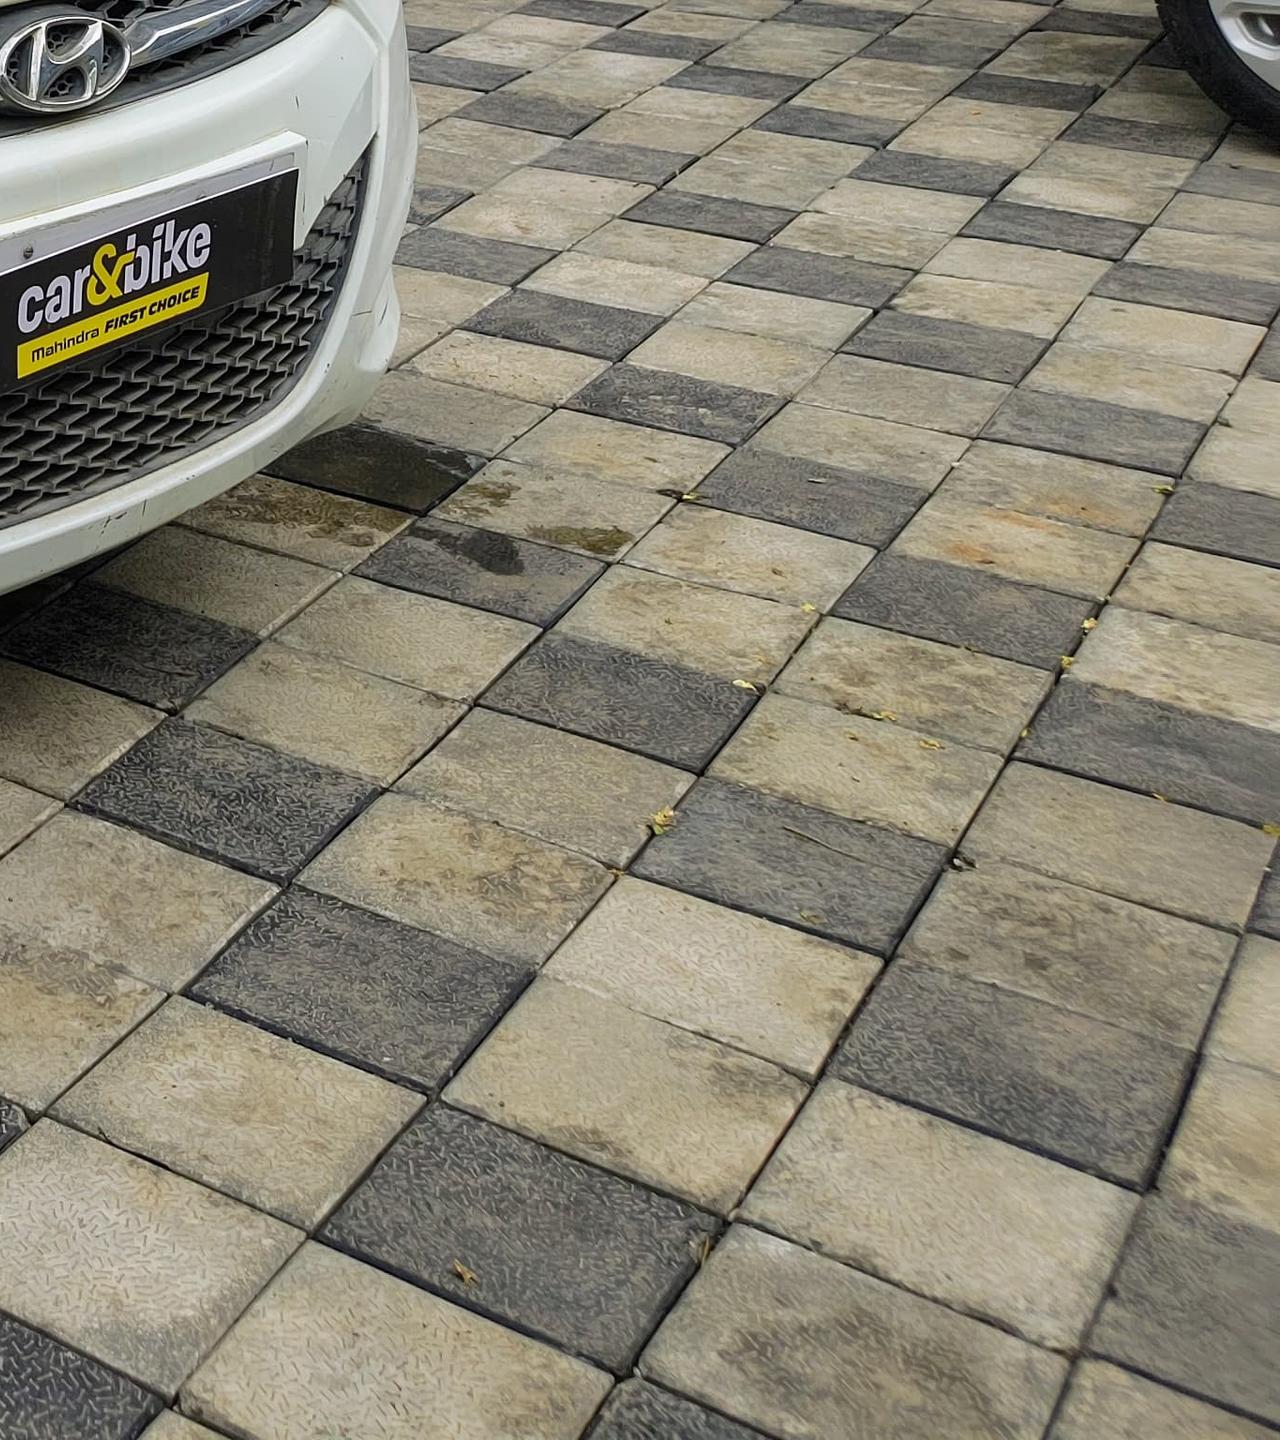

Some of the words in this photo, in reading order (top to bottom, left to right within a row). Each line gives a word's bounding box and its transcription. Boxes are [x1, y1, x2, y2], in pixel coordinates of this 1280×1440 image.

[17, 219, 211, 334] car&bike
[31, 327, 100, 363] Mahindra
[104, 308, 148, 334] FIRST
[148, 286, 200, 316] CHOICE
